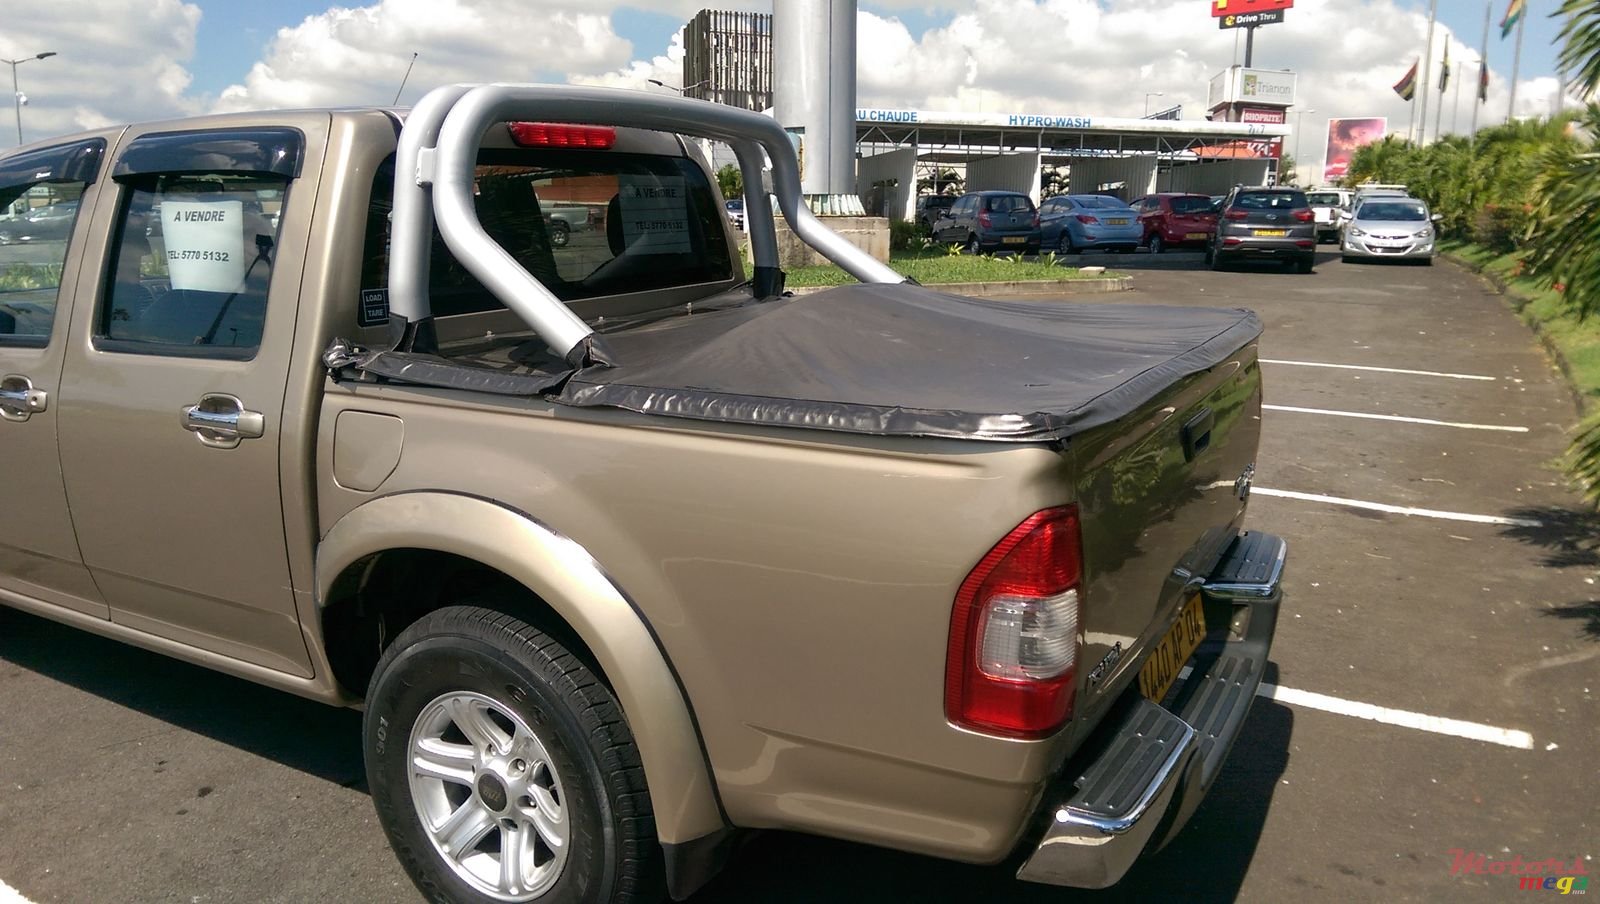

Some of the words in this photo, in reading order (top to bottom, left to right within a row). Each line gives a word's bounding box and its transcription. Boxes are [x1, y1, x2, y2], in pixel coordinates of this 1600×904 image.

[1236, 14, 1258, 24] Drive
[1259, 13, 1277, 21] Thru
[1257, 81, 1291, 95] Trianon
[870, 110, 918, 122] CHAUDE
[1009, 115, 1091, 128] HYPRO-WASH
[1244, 112, 1281, 123] SHOPRITE
[635, 188, 642, 198] A
[173, 211, 181, 222] A
[185, 211, 225, 222] VENDRE
[181, 250, 200, 260] 5770
[202, 251, 229, 262] 5132
[365, 294, 383, 302] LOAD
[367, 309, 385, 317] TARE
